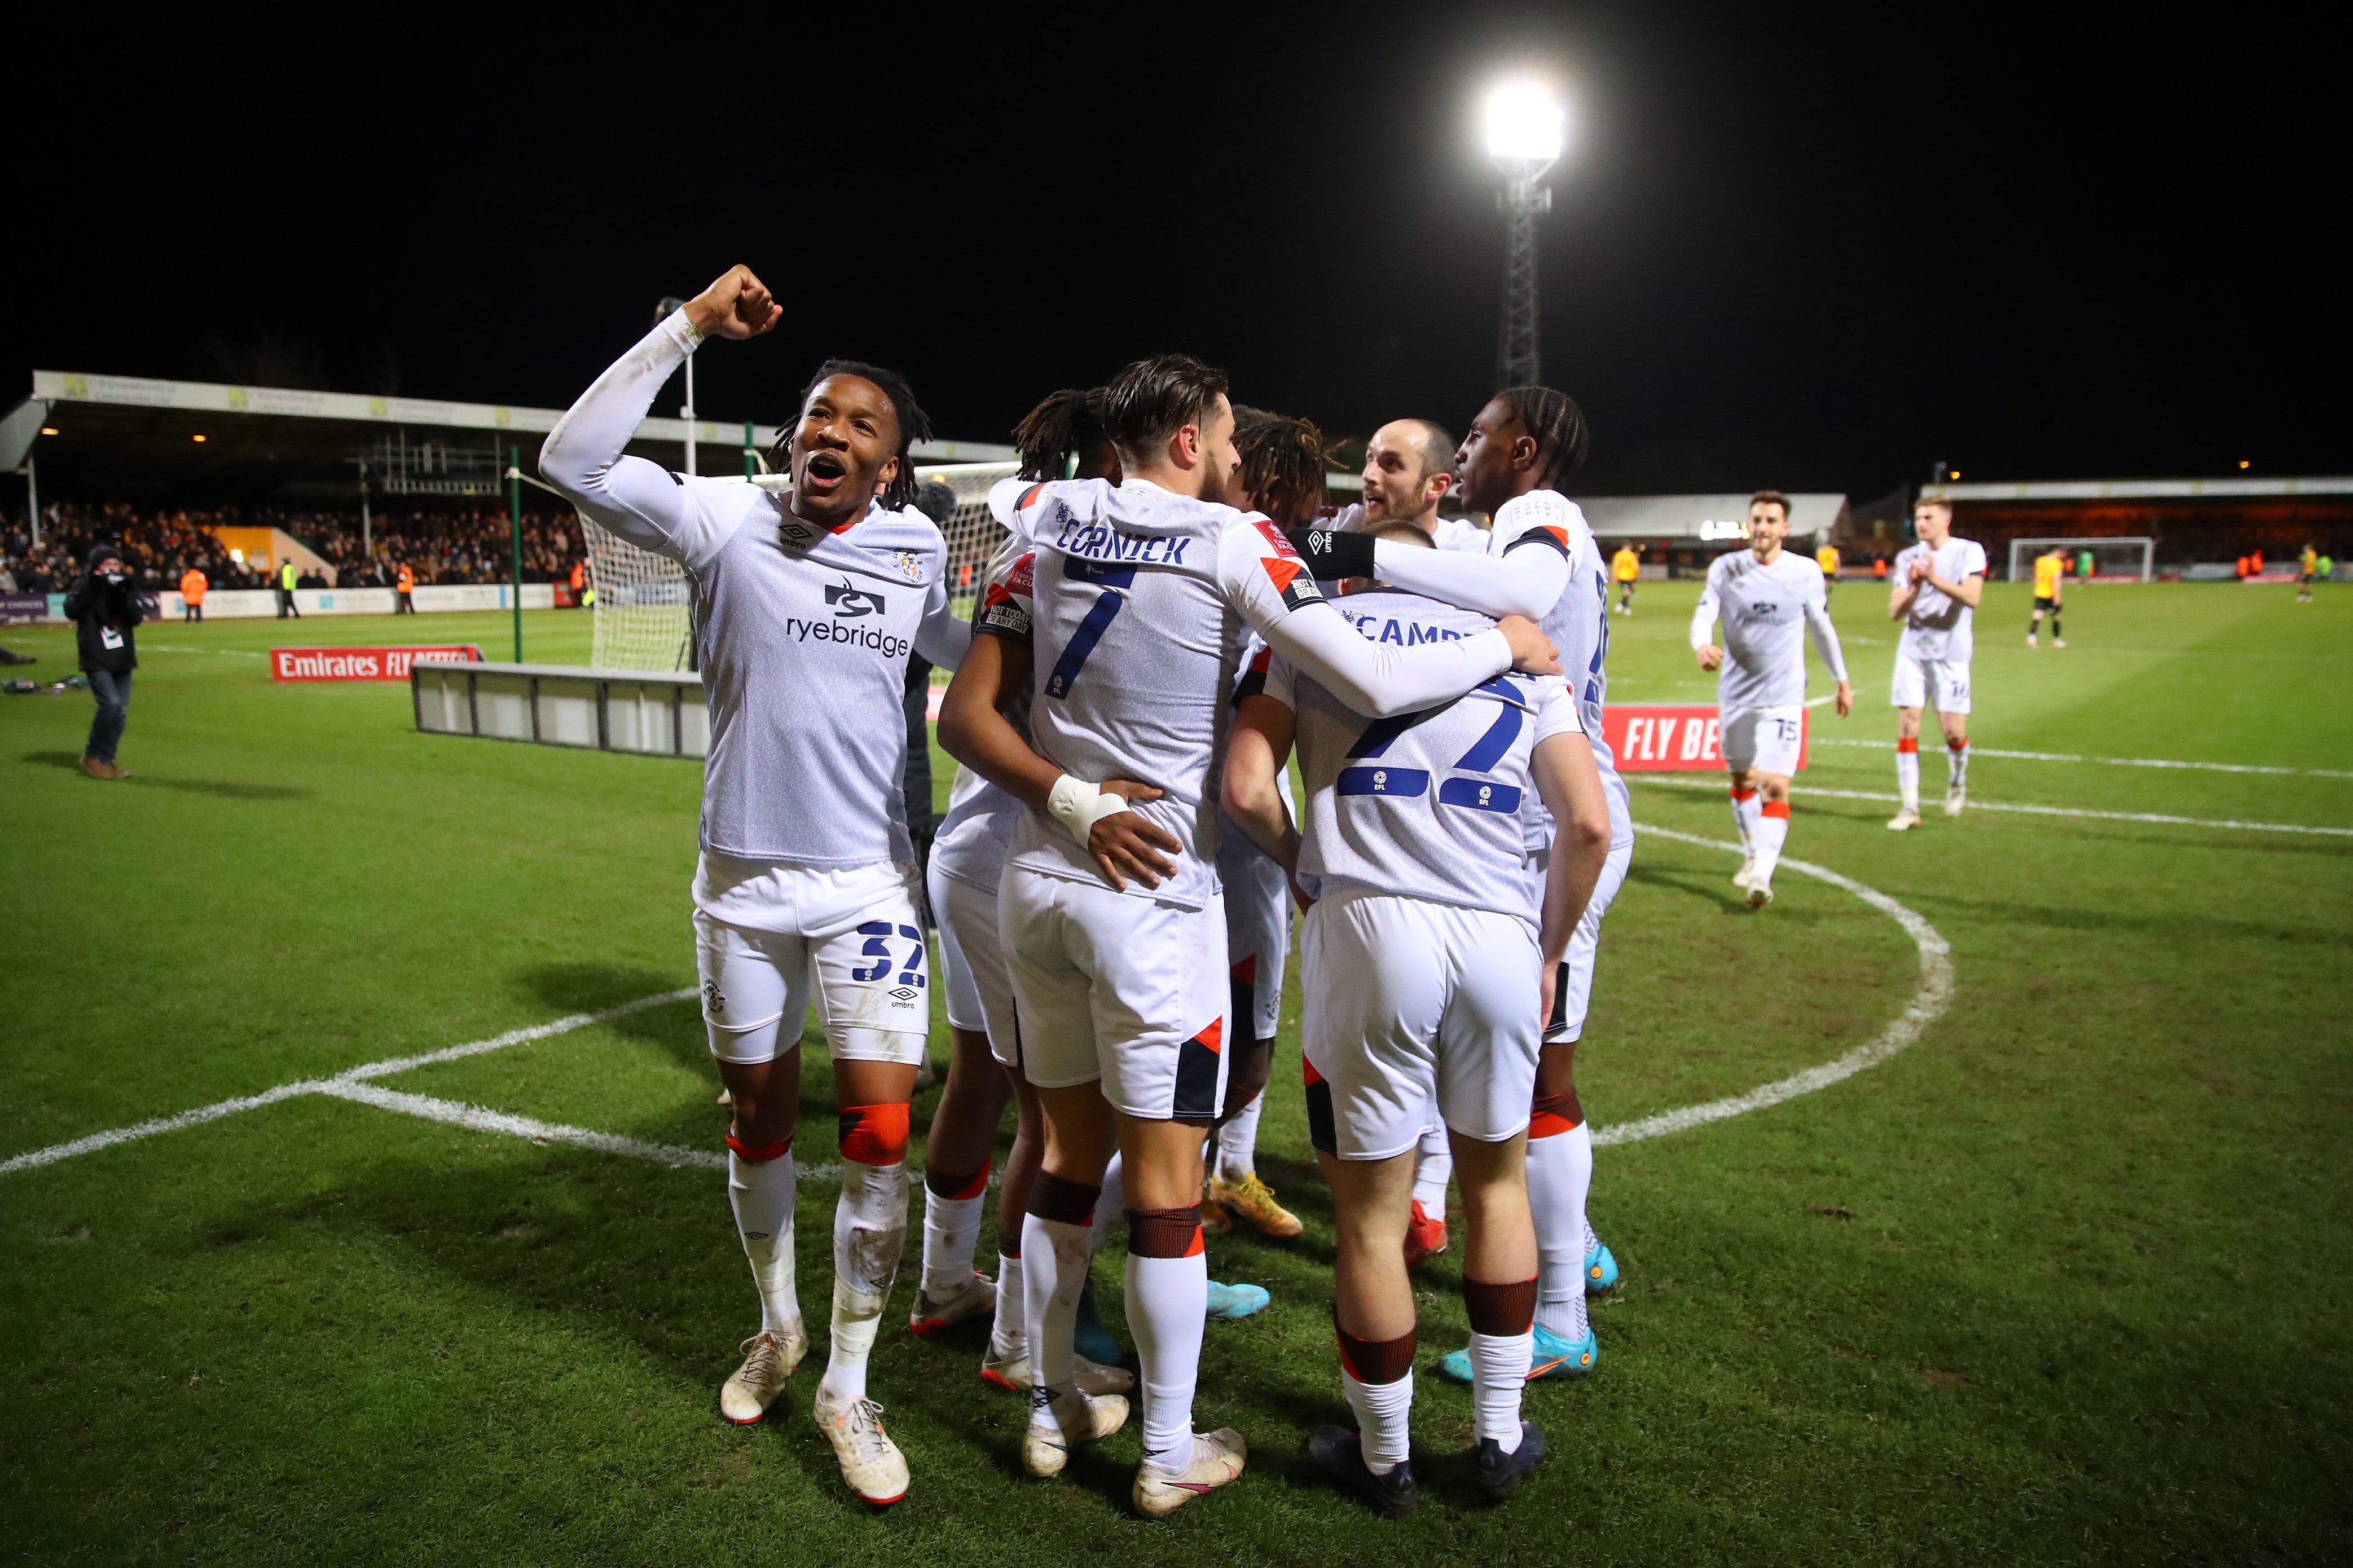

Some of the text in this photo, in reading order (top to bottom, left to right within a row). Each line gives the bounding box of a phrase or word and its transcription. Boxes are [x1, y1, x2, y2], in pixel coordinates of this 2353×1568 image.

[780, 538, 806, 549] umbro
[1057, 519, 1191, 564] CORNICK
[1015, 571, 1033, 580] Emira
[990, 605, 1032, 624] NOT TODAY
[996, 616, 1012, 627] ANY
[1012, 619, 1028, 632] DAY
[1044, 554, 1138, 700] 7
[787, 618, 908, 658] ryebridge
[278, 651, 412, 677] Emirates FLY
[1337, 676, 1527, 814] 22
[1623, 717, 1719, 760] FLY BE
[1776, 718, 1797, 742] 15
[852, 922, 925, 988] 32
